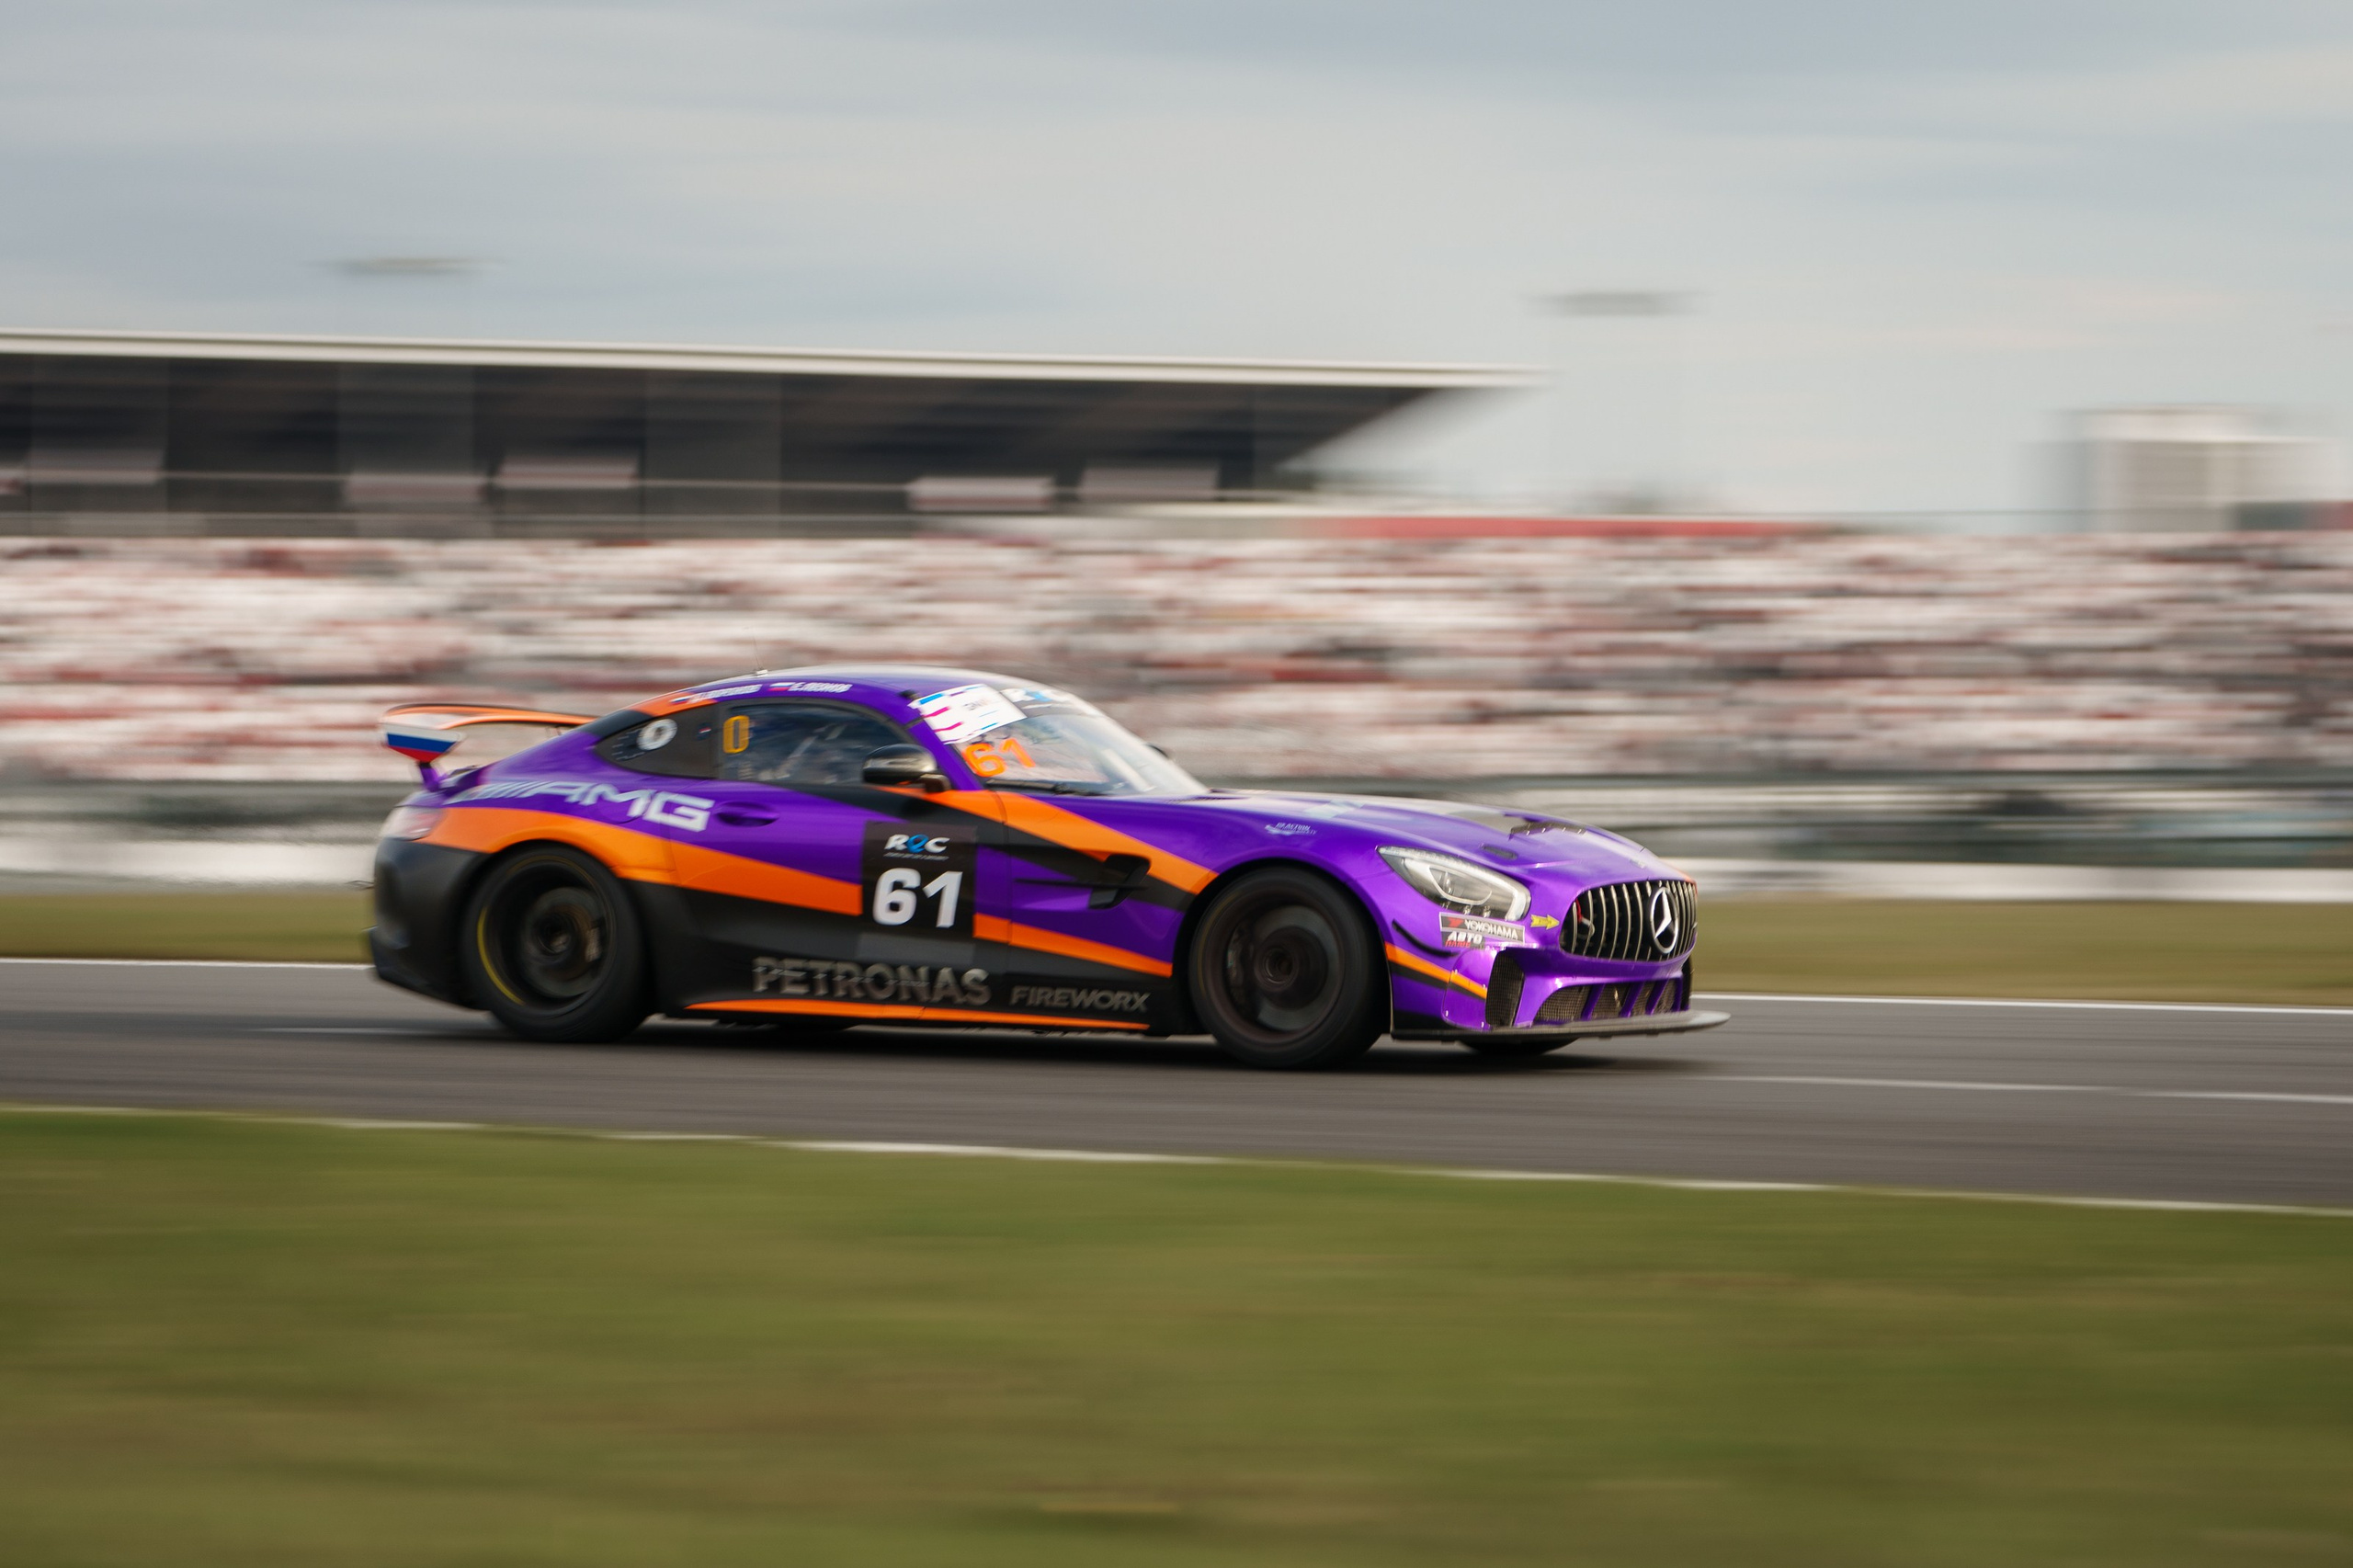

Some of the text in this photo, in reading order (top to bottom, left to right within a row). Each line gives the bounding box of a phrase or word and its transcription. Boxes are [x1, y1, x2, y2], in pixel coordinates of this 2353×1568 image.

[961, 737, 1035, 778] 61
[517, 781, 715, 833] AMG
[872, 867, 963, 928] 61
[1464, 919, 1518, 940] YOKOHAMA
[752, 956, 991, 1006] PETRONAS
[1011, 984, 1151, 1012] FIREWORX
